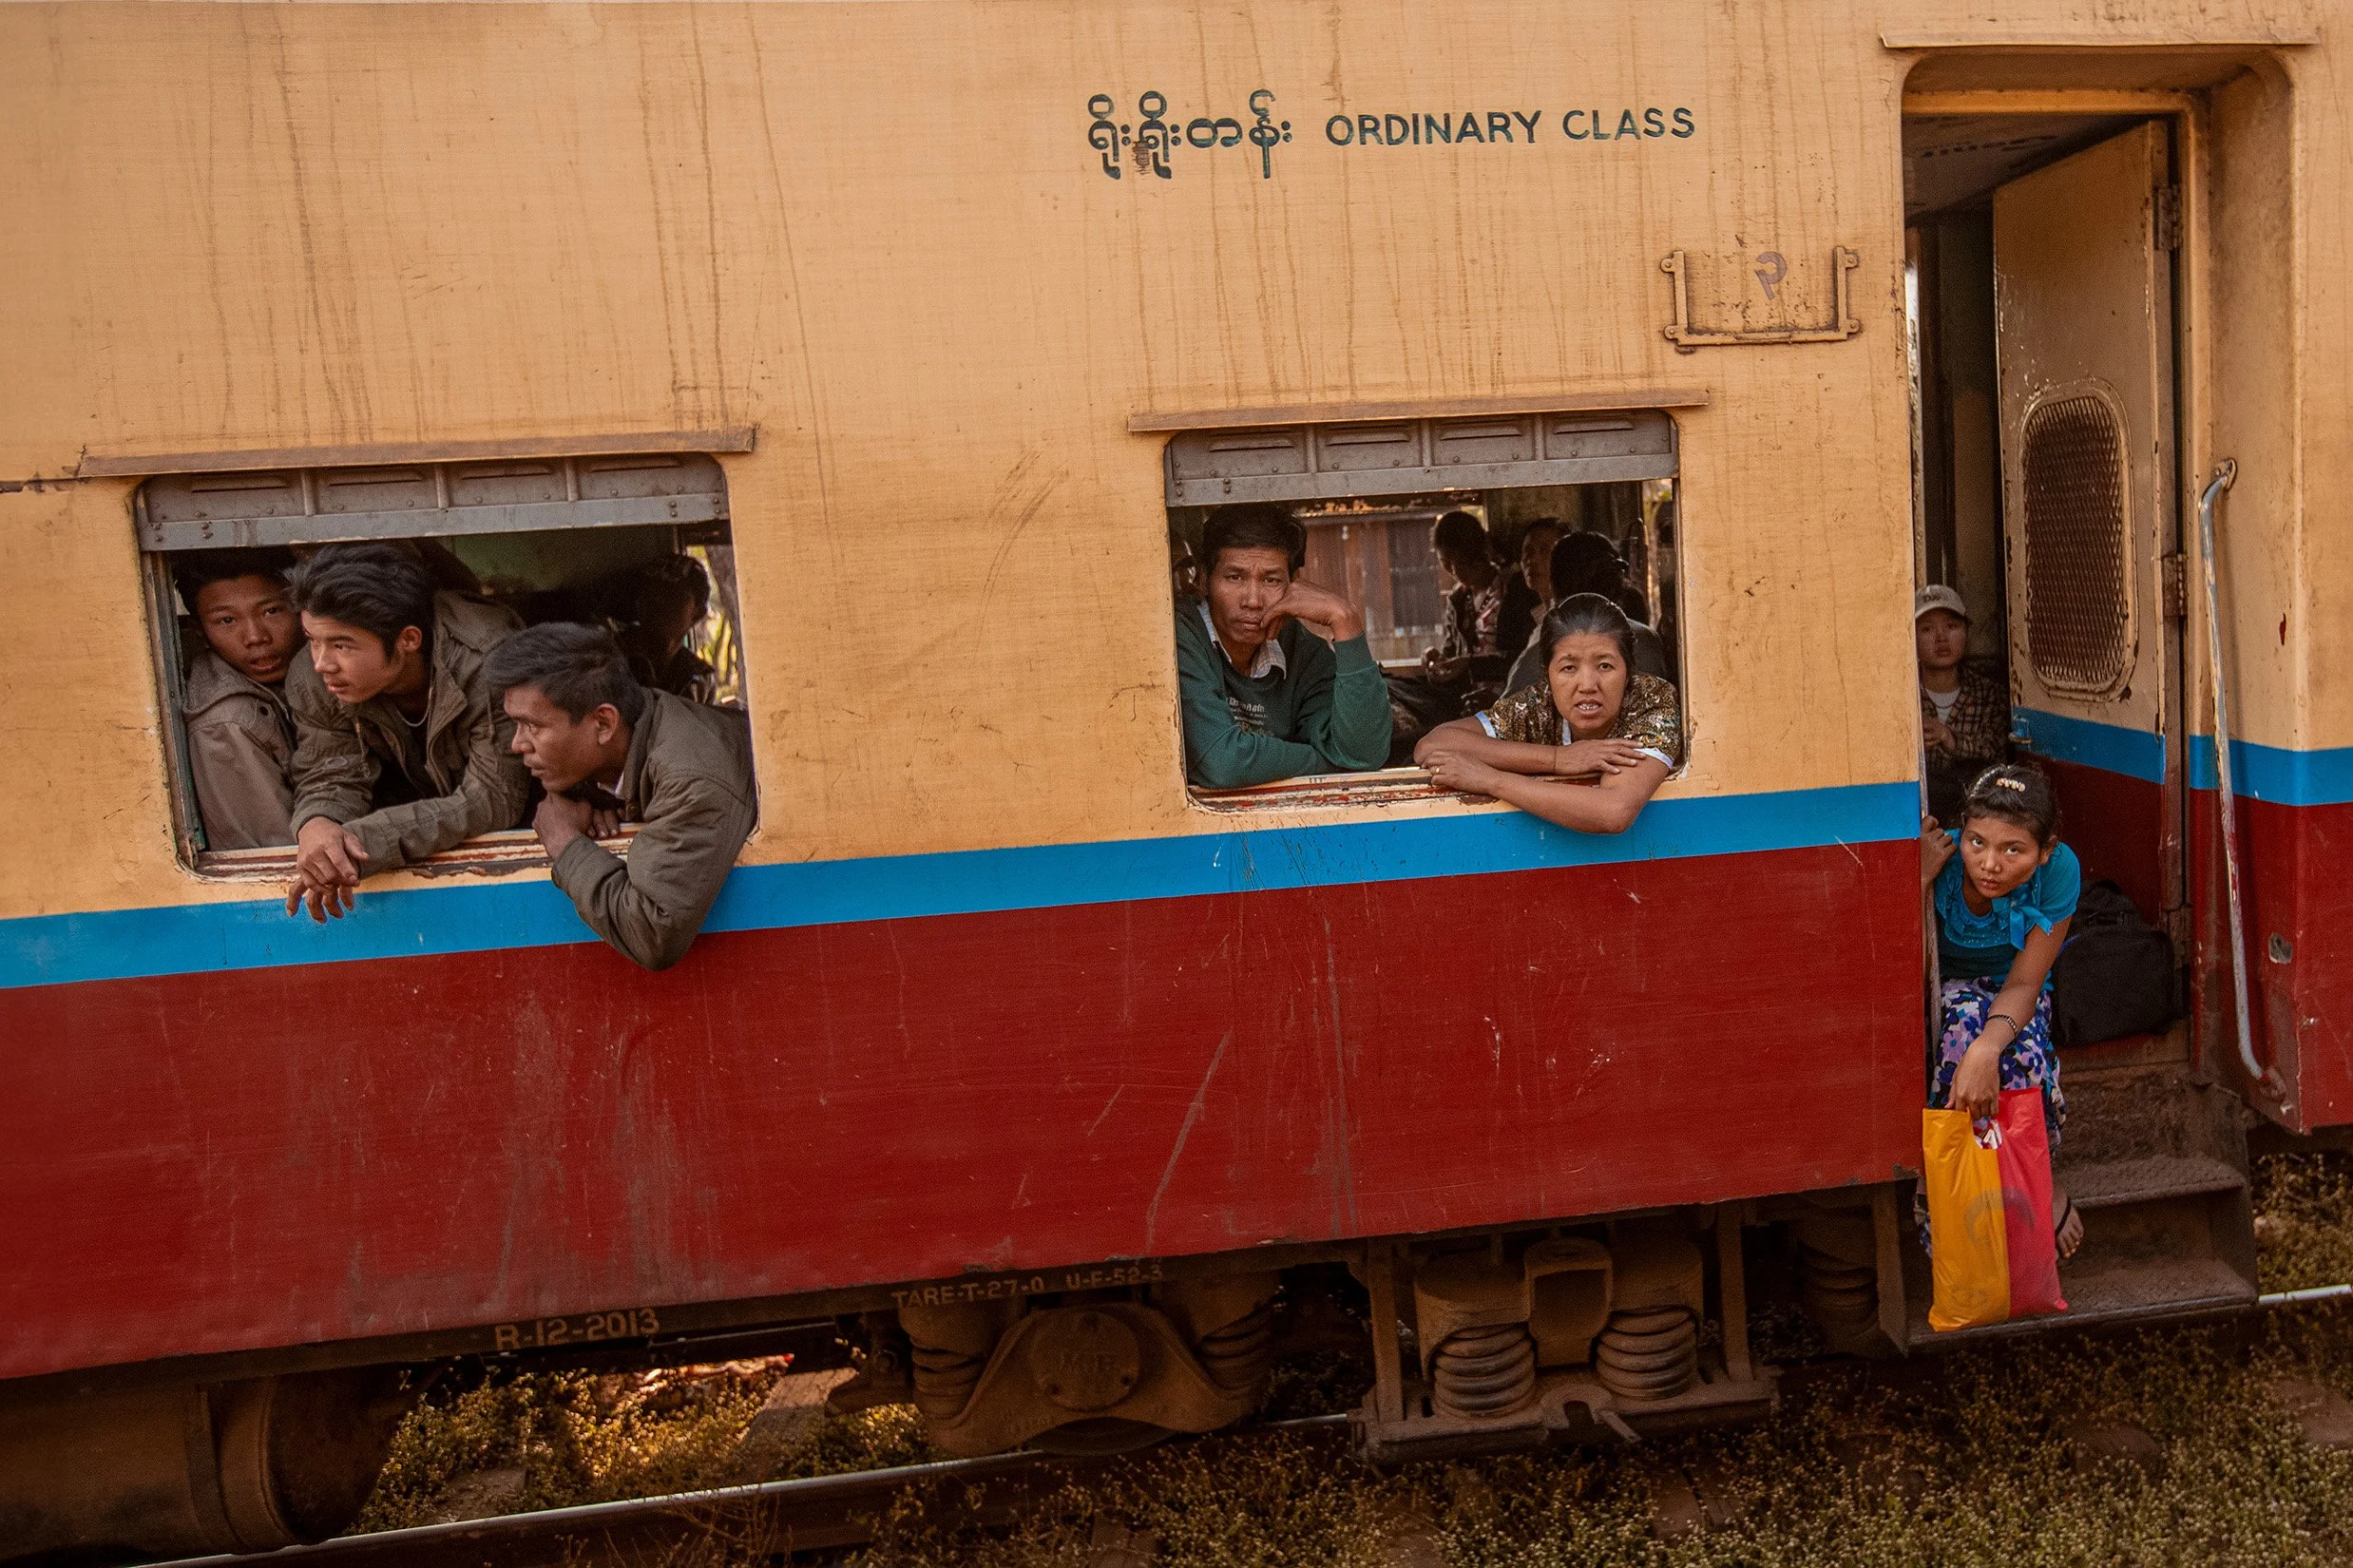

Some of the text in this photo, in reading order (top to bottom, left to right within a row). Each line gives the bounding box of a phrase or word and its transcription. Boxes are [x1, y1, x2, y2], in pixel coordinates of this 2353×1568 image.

[1325, 109, 1542, 146] ORDINARY
[1561, 107, 1696, 142] CLASS
[493, 1307, 660, 1351] R-12-2013
